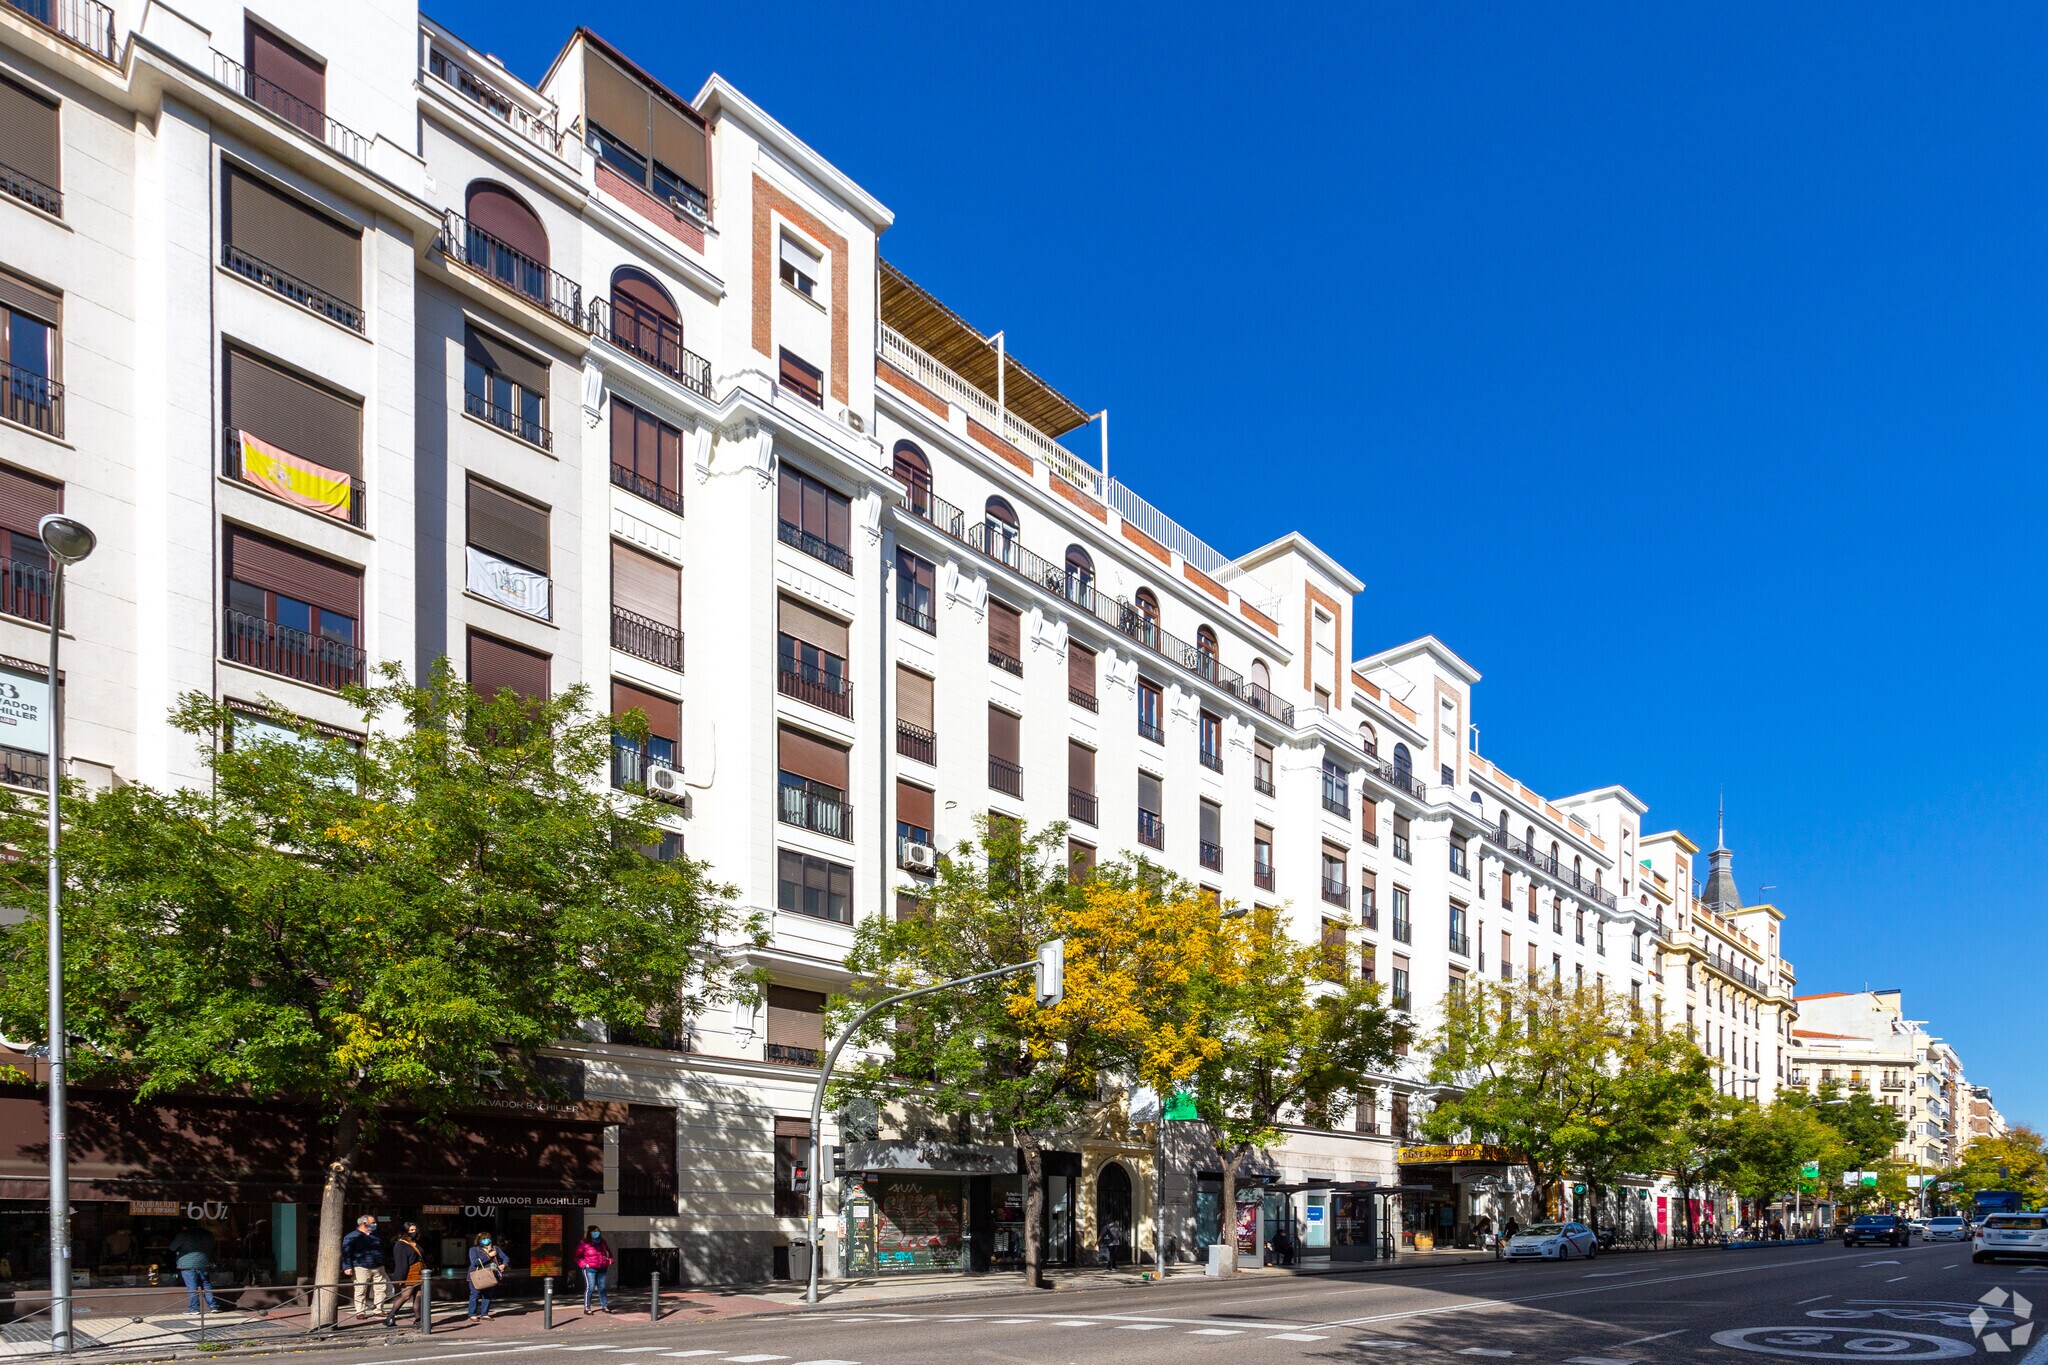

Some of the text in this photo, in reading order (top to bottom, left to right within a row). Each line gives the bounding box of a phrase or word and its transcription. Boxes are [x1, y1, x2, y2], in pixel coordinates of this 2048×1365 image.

[0, 698, 38, 713] ADOR
[474, 1099, 579, 1113] ALVADOR BACHILLER
[478, 1196, 590, 1206] SALVADOR BACHILLER
[1765, 1331, 1911, 1352] 30
